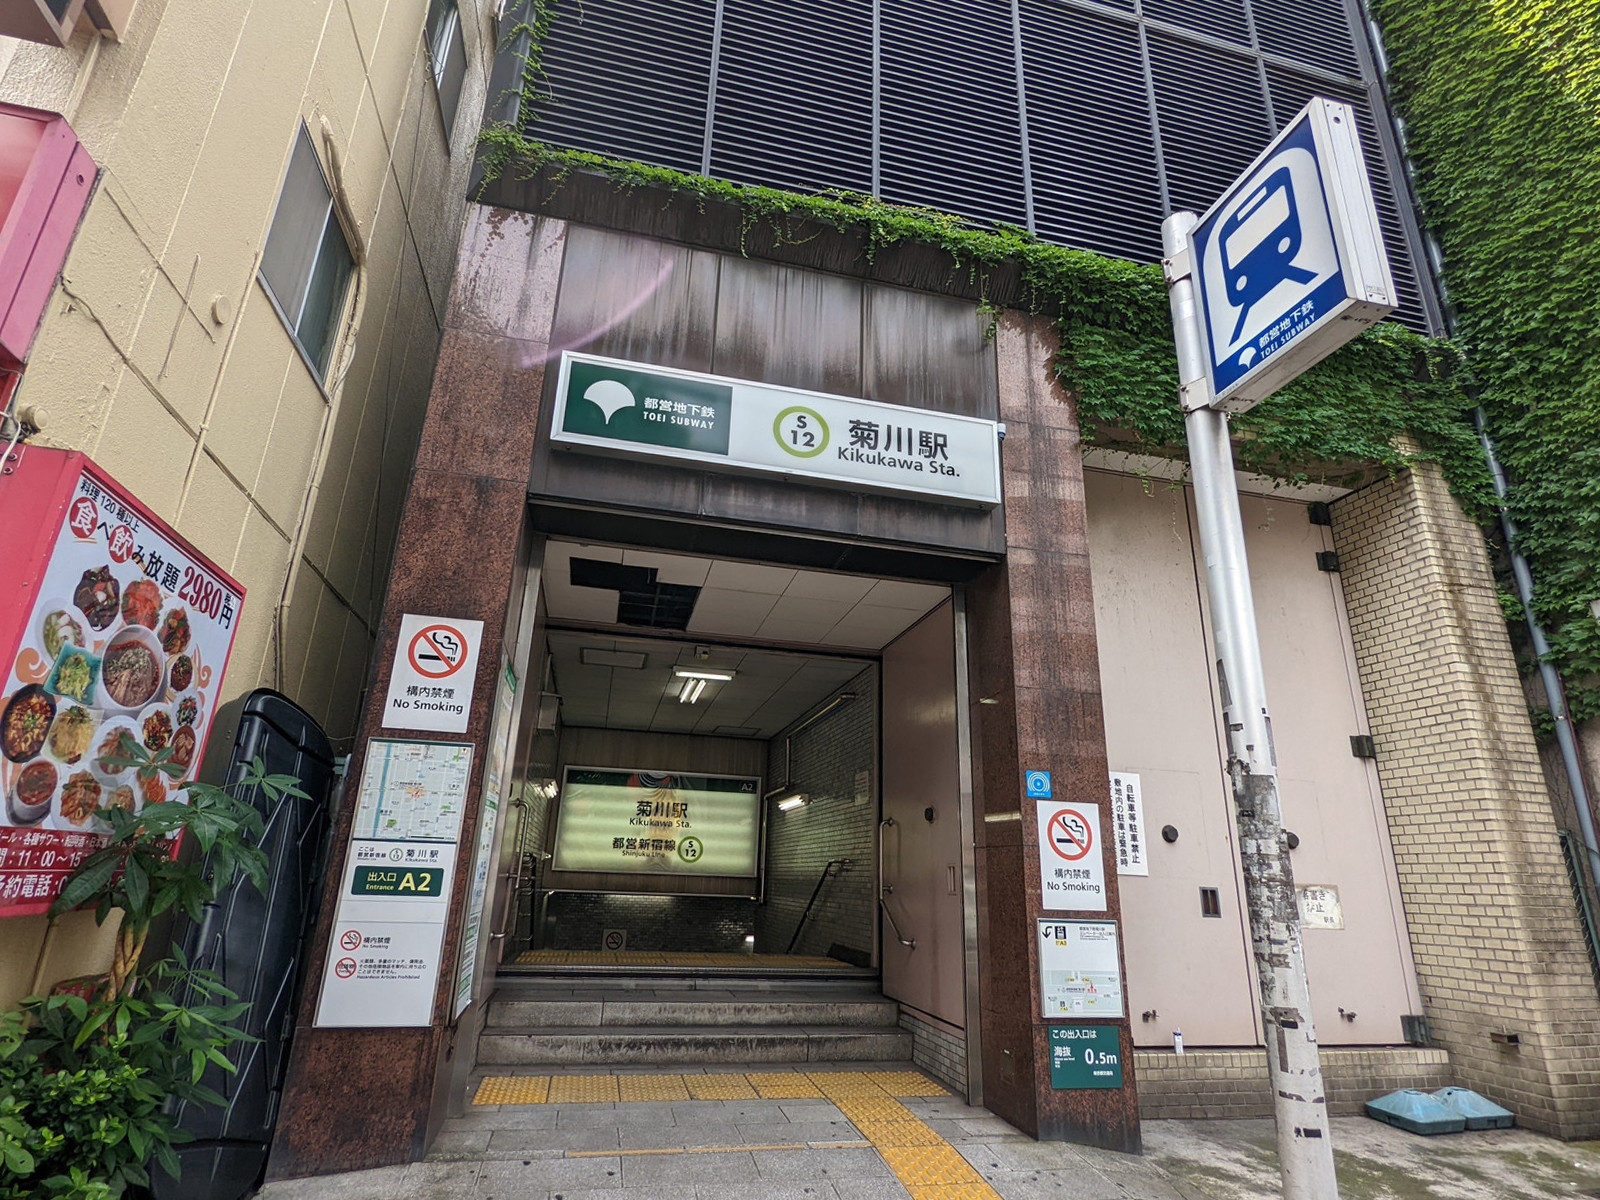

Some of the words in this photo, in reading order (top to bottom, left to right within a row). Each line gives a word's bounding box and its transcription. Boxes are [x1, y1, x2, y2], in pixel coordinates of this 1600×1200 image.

[1258, 299, 1314, 349] 都営地下鉄
[1260, 342, 1279, 359] TOEI
[1280, 313, 1316, 344] SUBWAY
[643, 396, 716, 418] 都営地下鉄
[643, 411, 666, 423] TOEI
[670, 415, 715, 430] SUBWAY
[796, 414, 807, 429] S
[790, 429, 815, 448] 12
[848, 418, 949, 461] 菊川駅
[837, 446, 923, 472] Kikukawa
[929, 460, 961, 477] Sta.
[71, 500, 181, 594] 食べ飲み放題
[406, 685, 455, 699] 構内禁煙
[392, 698, 410, 709] No
[413, 700, 464, 715] Smoking
[740, 782, 754, 792] A2
[636, 800, 688, 819] 菊川駅
[629, 817, 673, 828] Kikukawa
[676, 820, 692, 829] Sta.
[1126, 783, 1141, 864] 自転車等駐車禁止
[612, 837, 677, 851] 都営新宿線
[688, 840, 694, 848] S
[405, 848, 439, 859] 菊川駅
[622, 850, 651, 859] Shinjuku
[684, 849, 697, 857] 12
[367, 871, 397, 882] 出入口
[1054, 868, 1092, 880] 構内禁煙
[365, 883, 395, 891] Entrance
[397, 872, 432, 892] A2
[1046, 881, 1060, 891] No
[1062, 882, 1100, 894] Smoking
[1052, 1029, 1098, 1039] この出入口は
[1084, 1048, 1118, 1065] 0.5m
